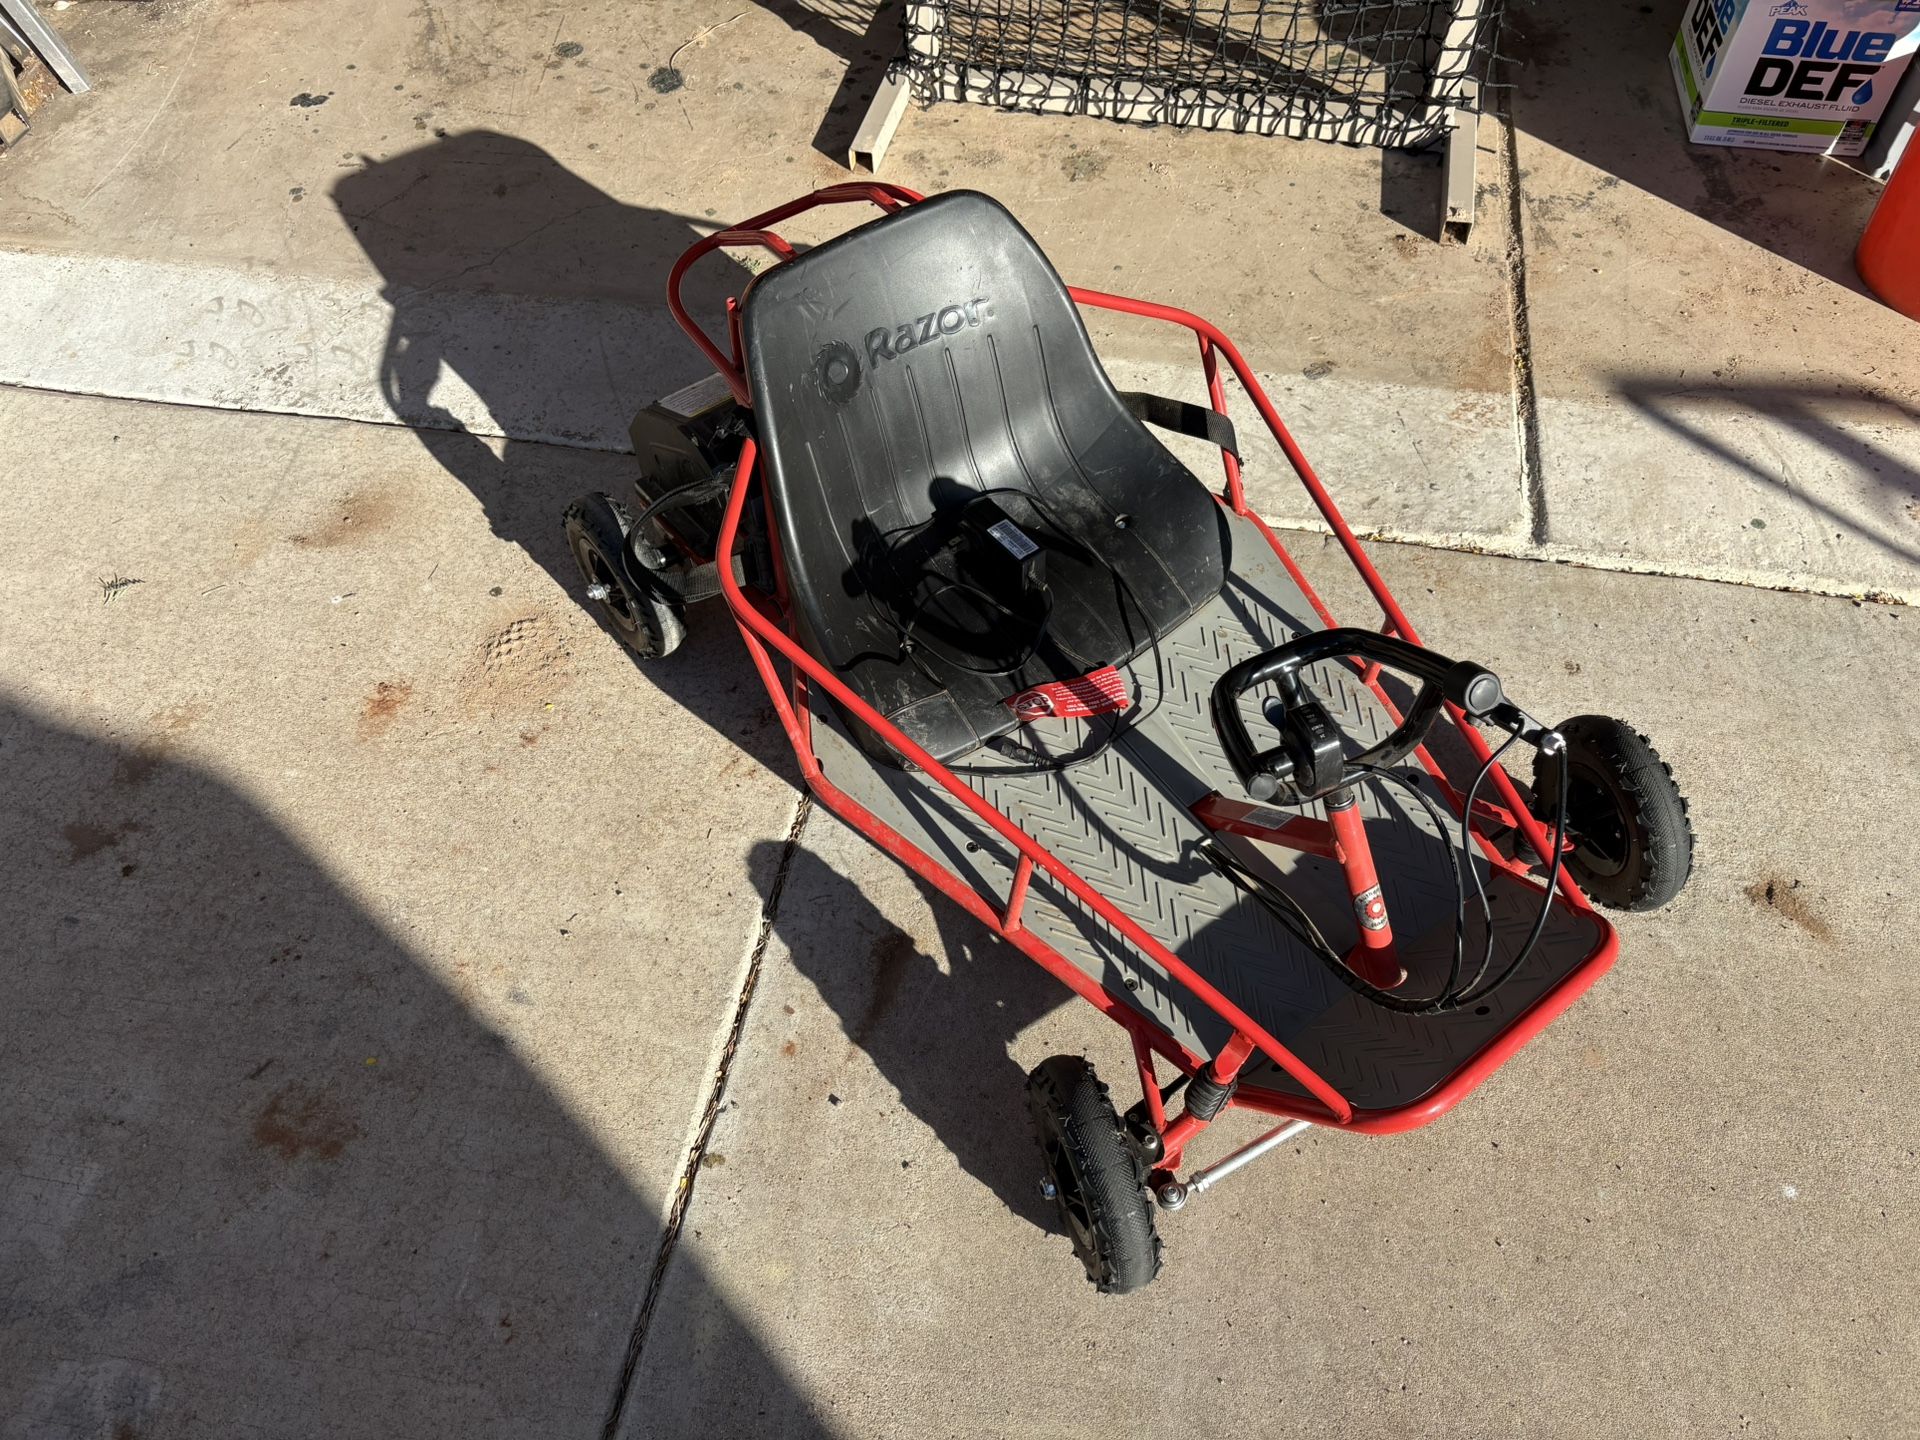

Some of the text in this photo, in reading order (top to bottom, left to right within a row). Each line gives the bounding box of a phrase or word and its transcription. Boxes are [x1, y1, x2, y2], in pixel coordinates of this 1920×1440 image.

[1769, 4, 1808, 17] PEAK
[1761, 18, 1896, 63] Blue
[1744, 57, 1881, 102] DEF
[1739, 97, 1777, 107] DIESEL
[1778, 100, 1828, 111] EXHAUST
[1828, 103, 1861, 112] FLUID
[1732, 116, 1790, 128] TRIPLE-FILTERED
[864, 296, 990, 370] Razor
[1017, 696, 1049, 711] STOP
